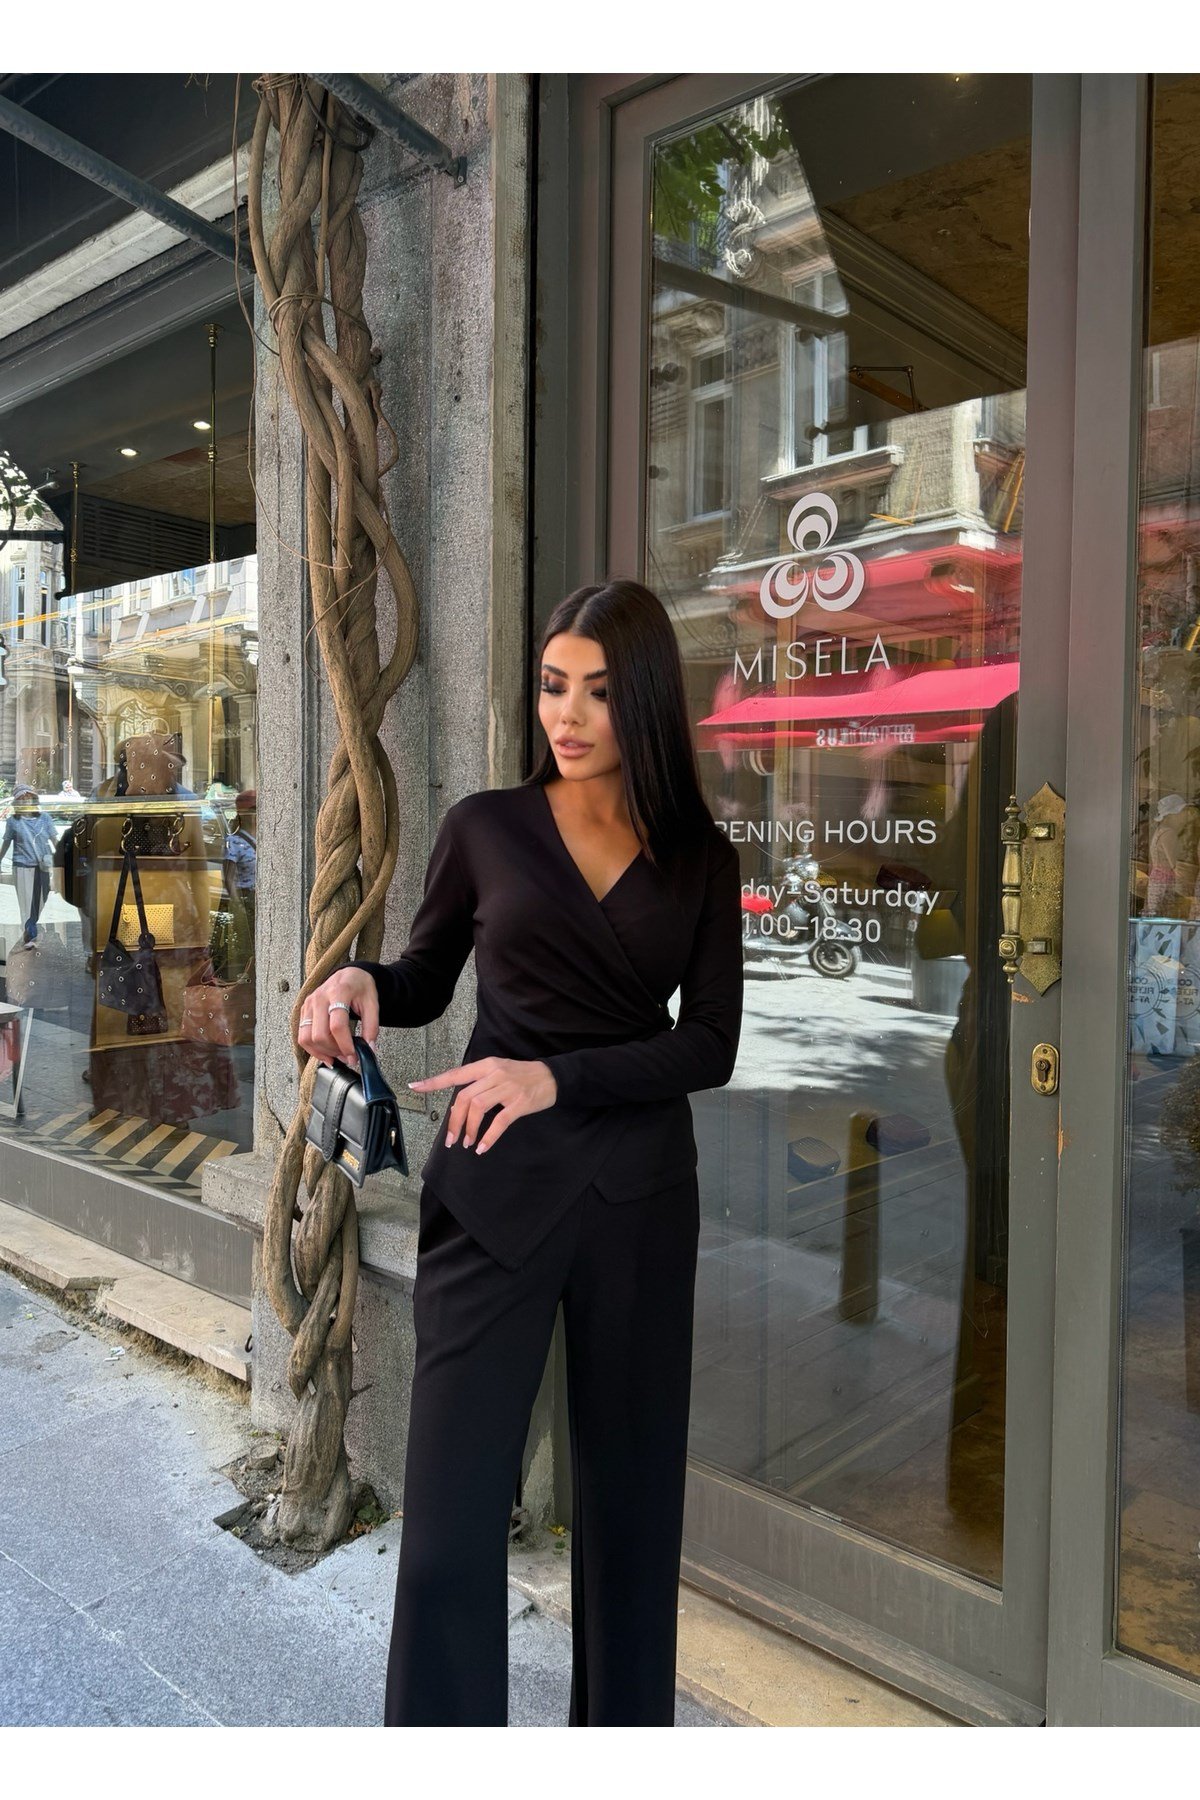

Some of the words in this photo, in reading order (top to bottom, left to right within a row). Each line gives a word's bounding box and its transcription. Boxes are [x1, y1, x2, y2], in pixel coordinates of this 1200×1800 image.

[733, 632, 891, 685] MISELA
[714, 820, 816, 843] ENING
[824, 819, 938, 845] HOURS
[741, 878, 940, 916] day–Saturday
[742, 912, 881, 943] 1.00–18.30
